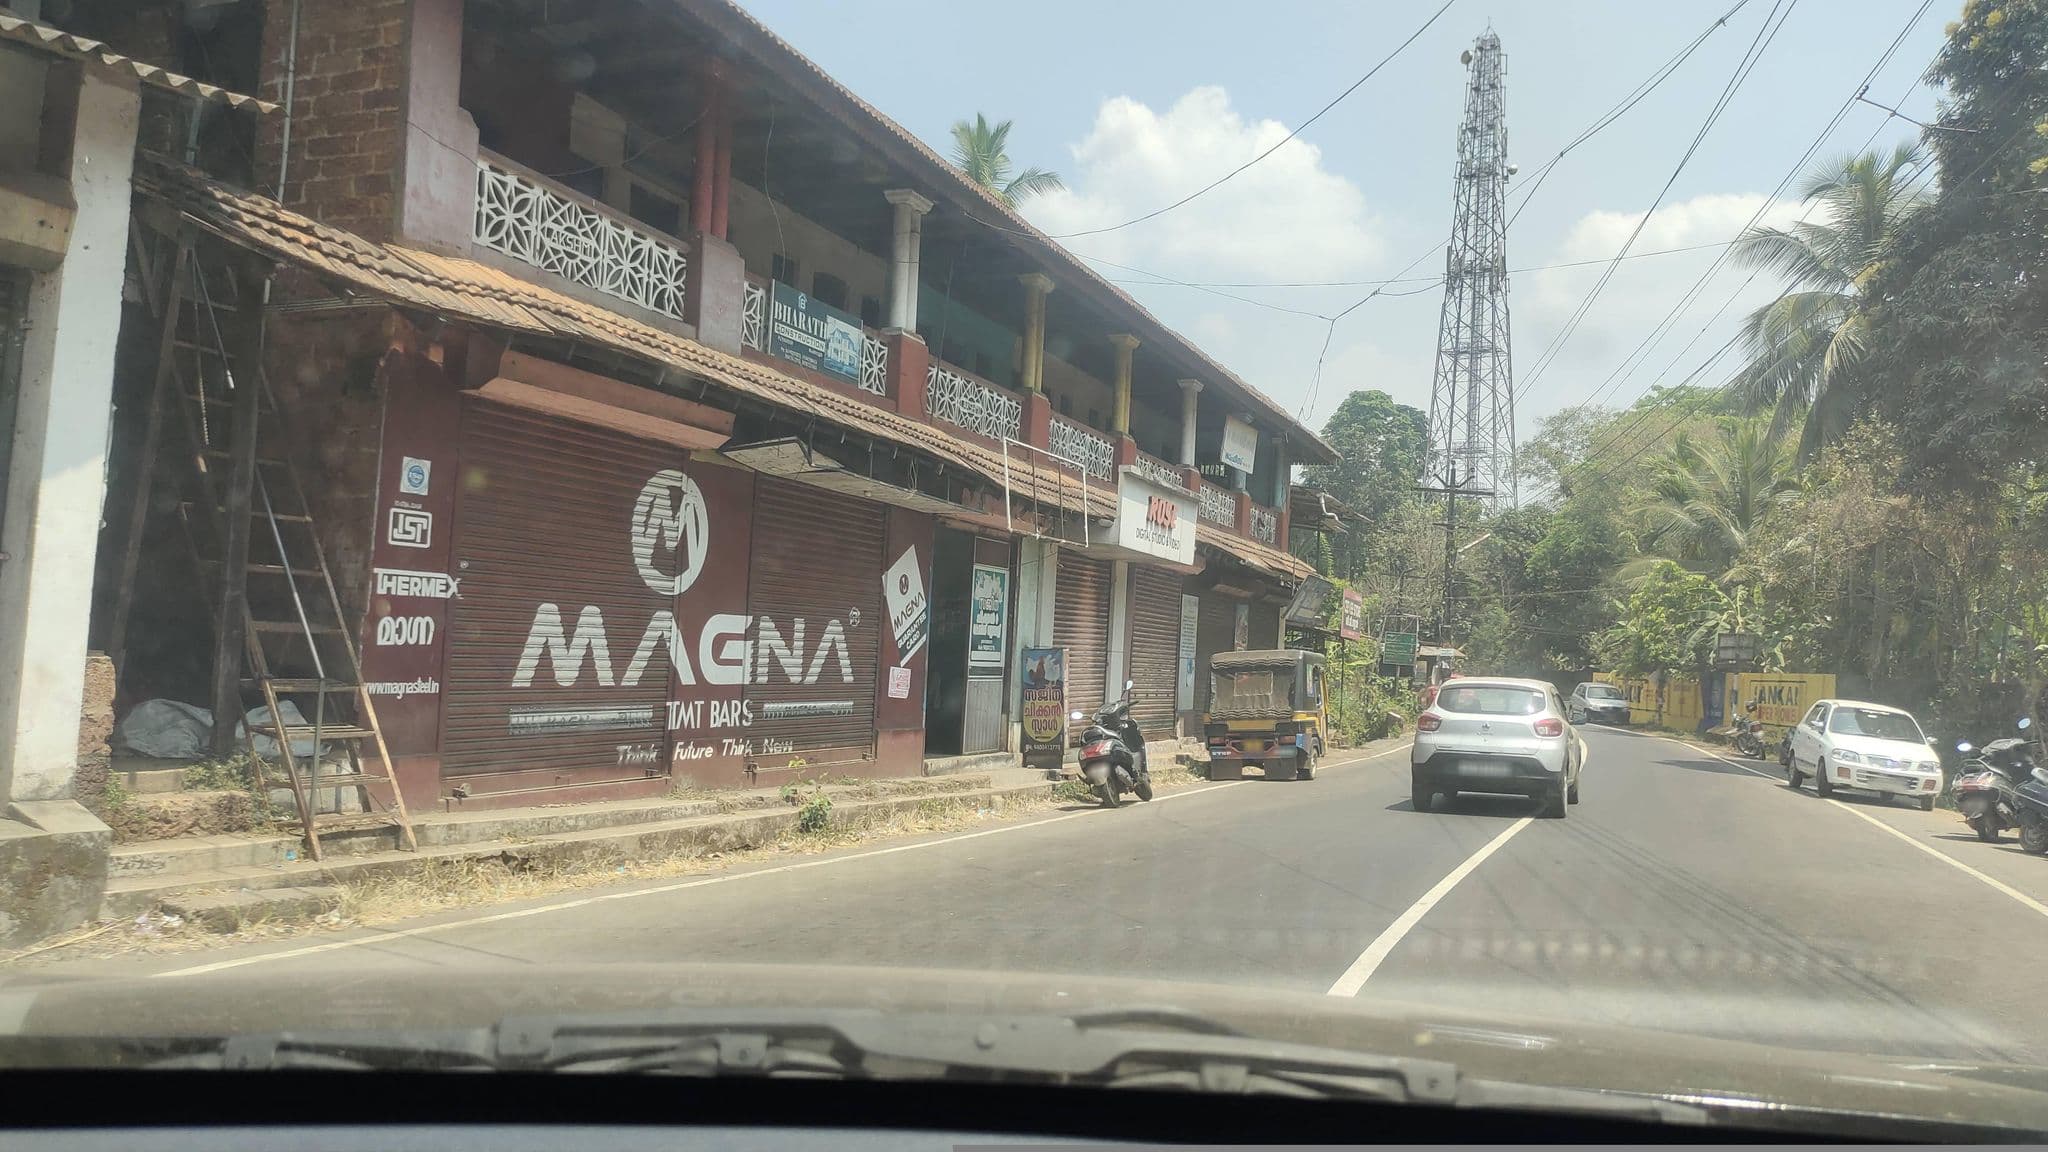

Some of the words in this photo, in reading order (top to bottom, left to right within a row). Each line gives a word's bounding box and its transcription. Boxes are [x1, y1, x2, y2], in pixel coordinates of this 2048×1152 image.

[775, 301, 827, 340] BHARATH
[511, 602, 855, 687] MAGNA
[666, 700, 704, 731] TMT
[709, 699, 753, 728] BARS
[616, 744, 658, 767] Think
[674, 740, 713, 761] Future
[722, 738, 753, 757] Think
[763, 737, 793, 754] Now
